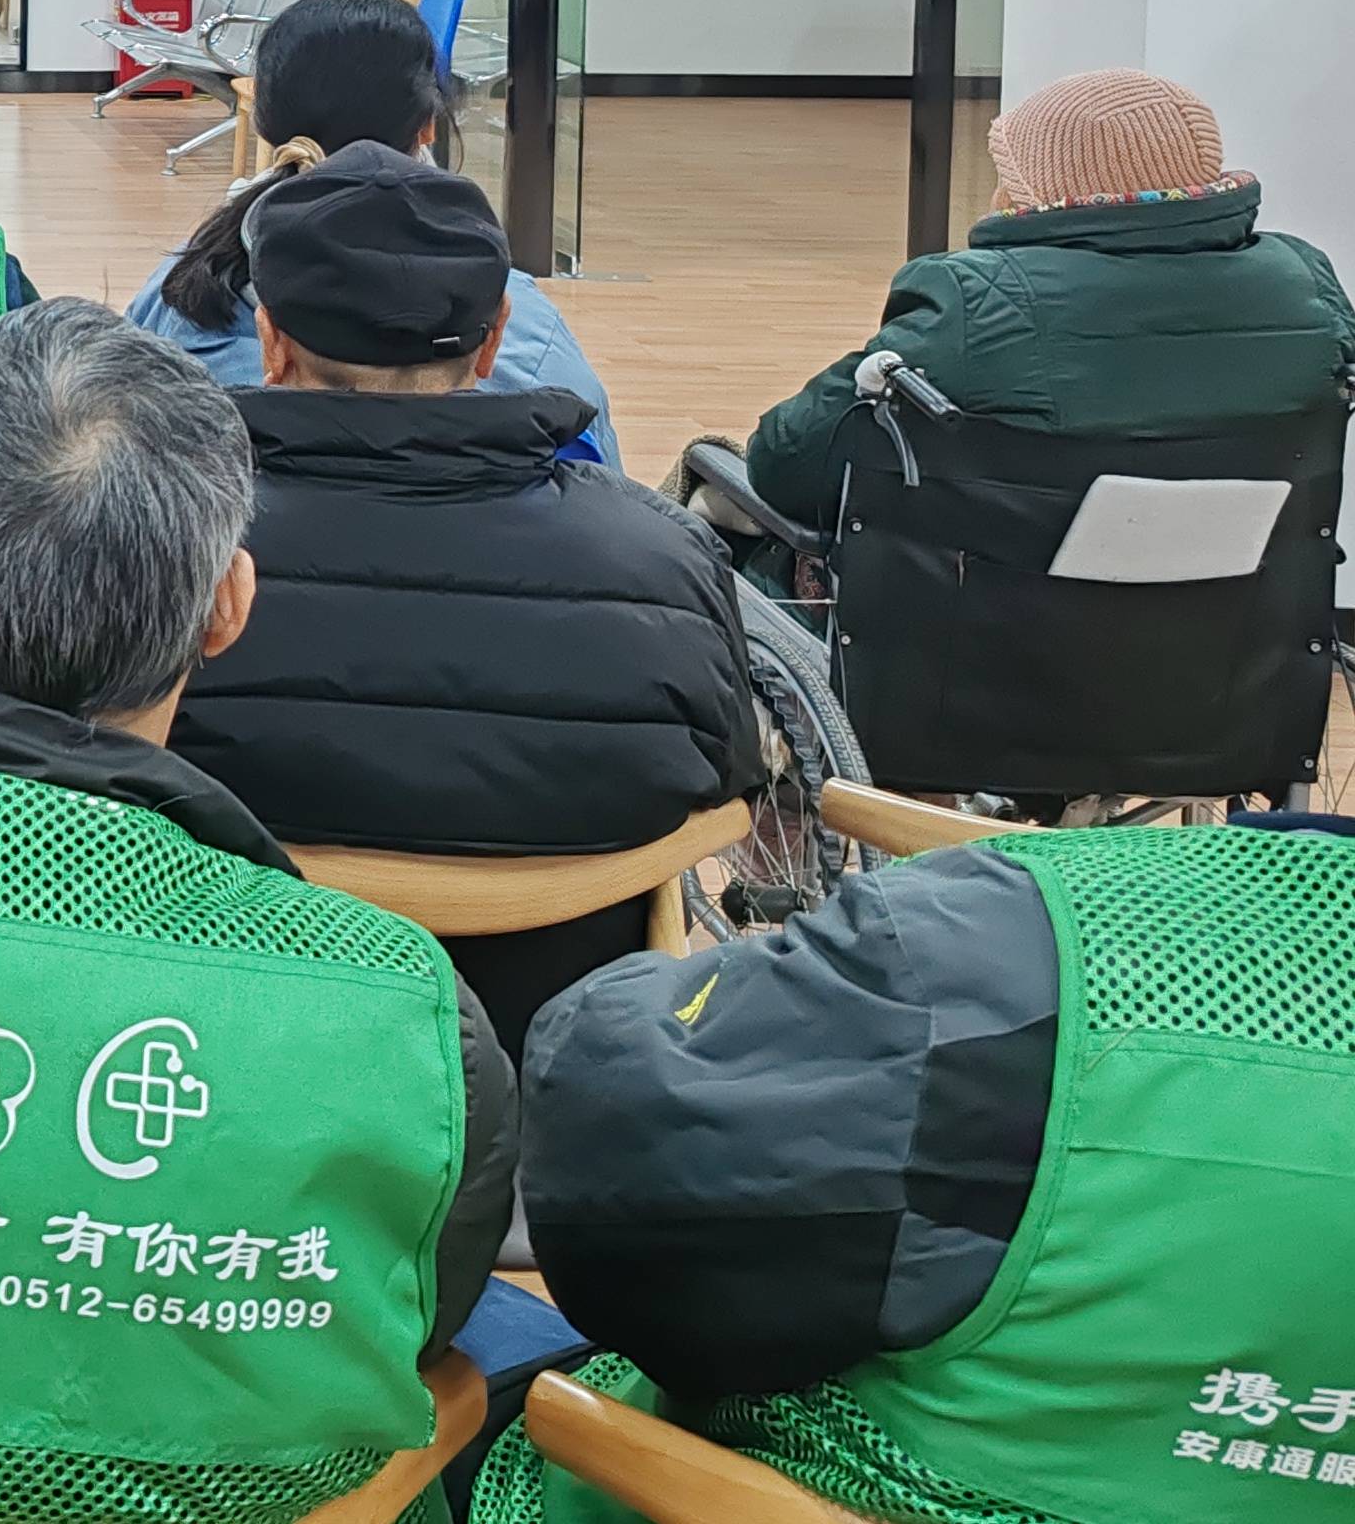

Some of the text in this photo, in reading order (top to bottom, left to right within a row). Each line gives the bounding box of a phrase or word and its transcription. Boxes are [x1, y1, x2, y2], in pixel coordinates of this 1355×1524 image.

[41, 1210, 339, 1283] 有你有我
[1189, 1368, 1355, 1434] 携手
